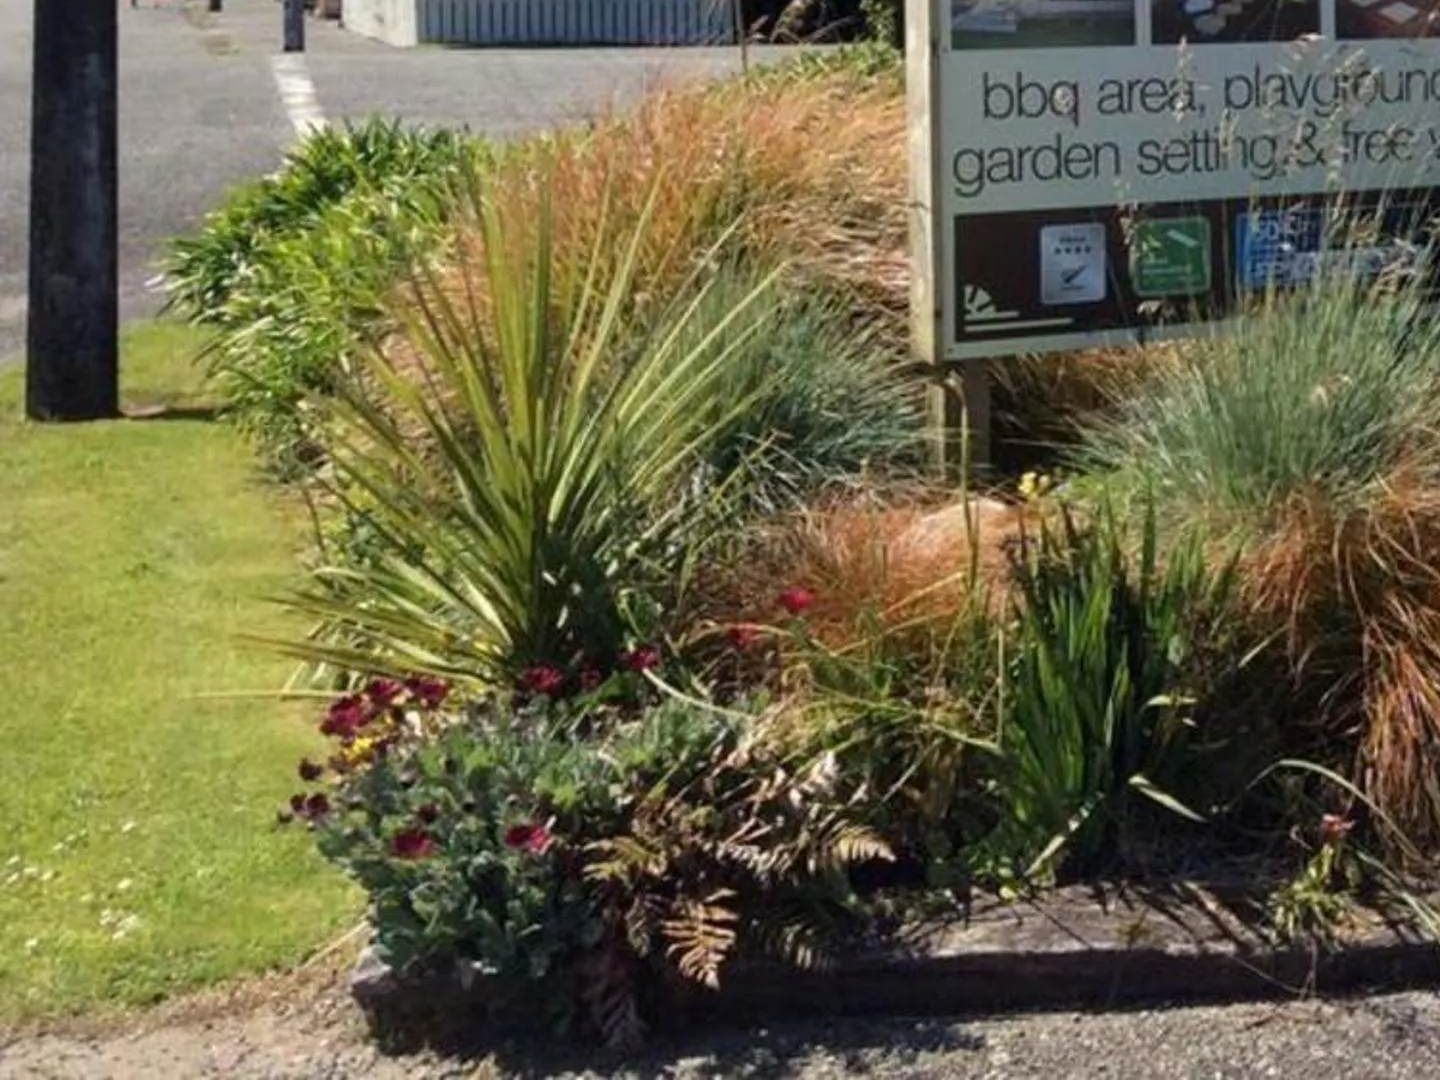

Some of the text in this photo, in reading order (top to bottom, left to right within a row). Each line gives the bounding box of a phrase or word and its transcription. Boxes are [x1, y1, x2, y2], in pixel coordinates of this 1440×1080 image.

[982, 71, 1080, 127] bbq
[1097, 76, 1206, 117] area,
[952, 132, 1121, 198] garden
[1342, 119, 1415, 164] free
